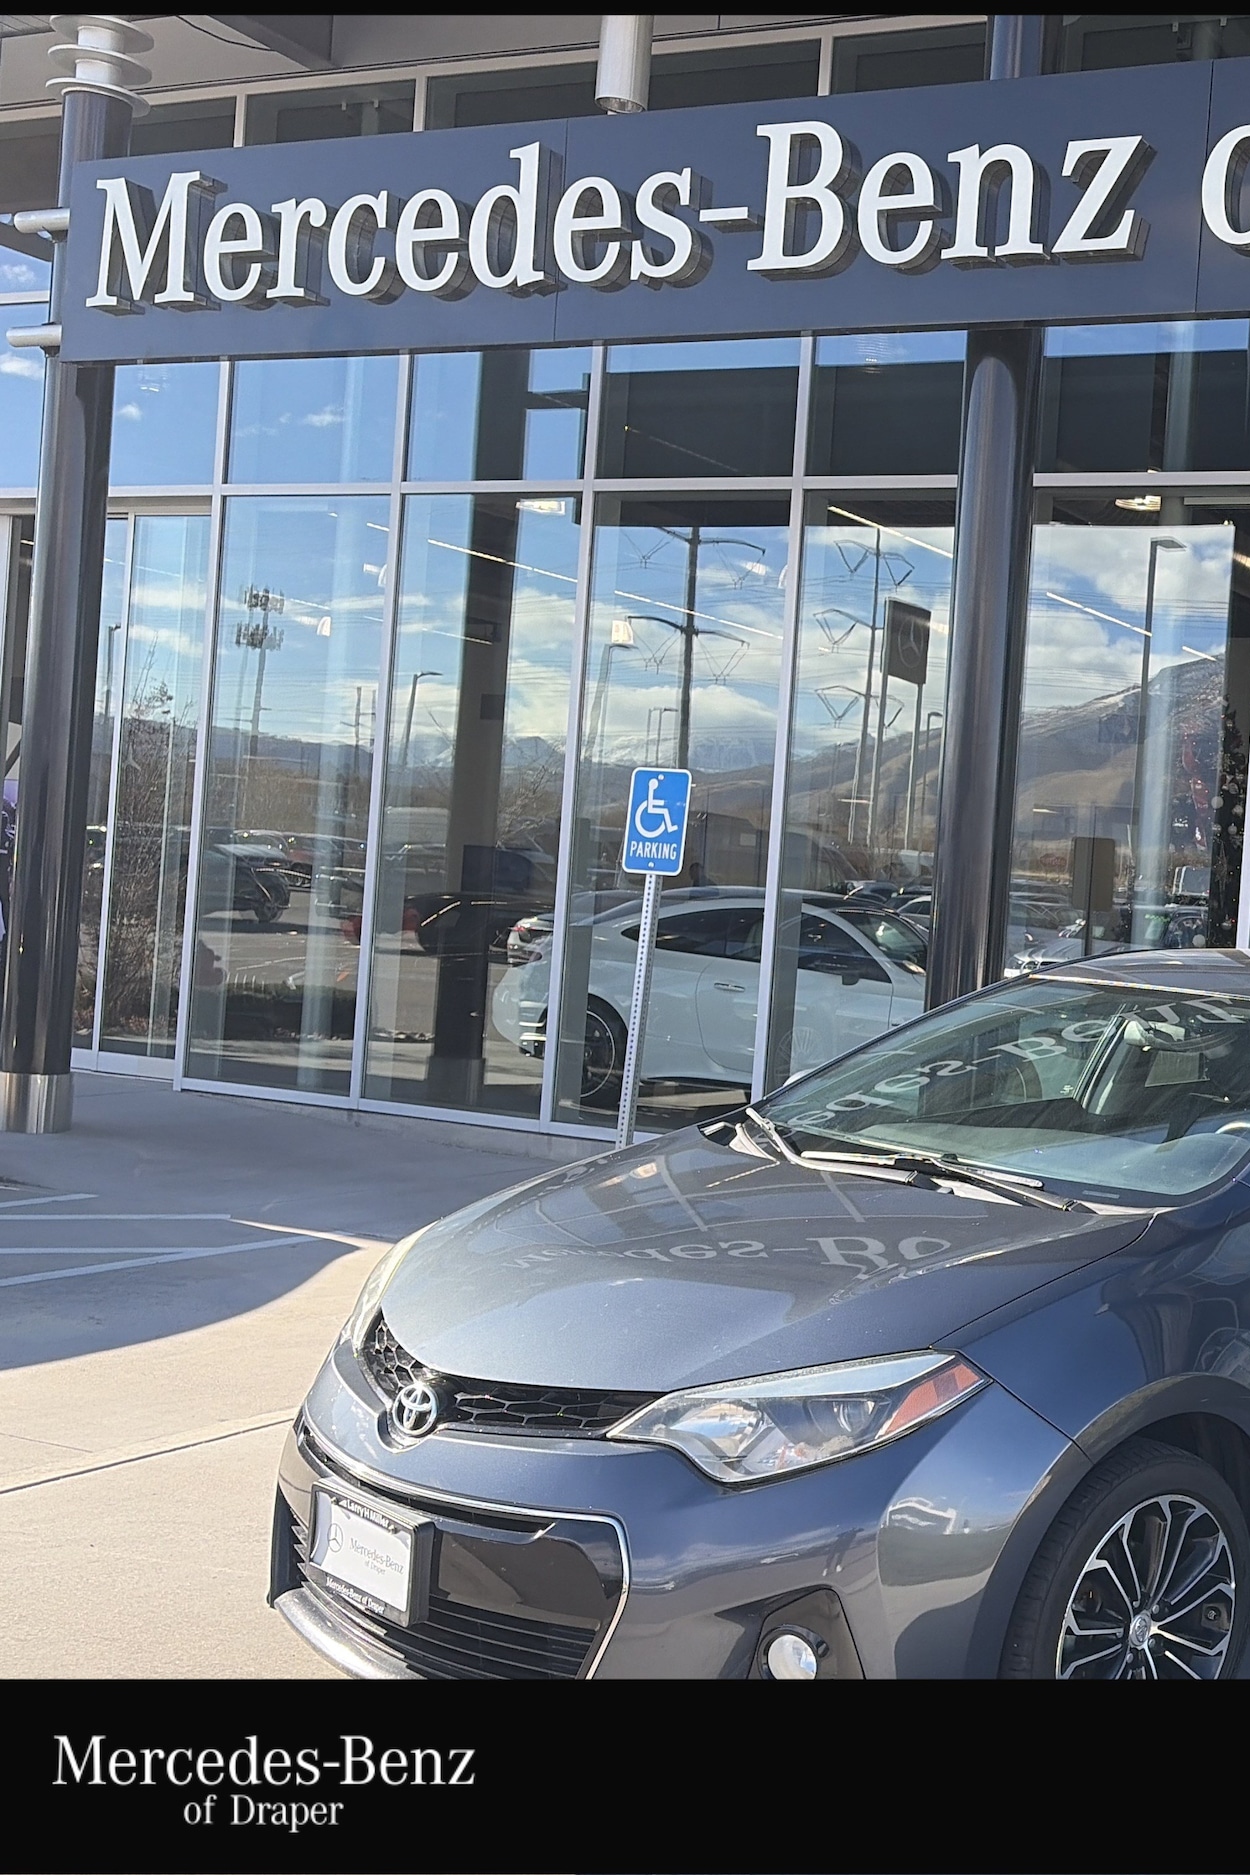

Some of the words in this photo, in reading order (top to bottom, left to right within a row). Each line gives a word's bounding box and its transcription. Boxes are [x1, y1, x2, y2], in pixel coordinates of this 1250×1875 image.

[86, 121, 1142, 306] Mercedes-Benz
[629, 840, 677, 860] PARKING
[349, 1537, 404, 1575] Mercedes-Benz
